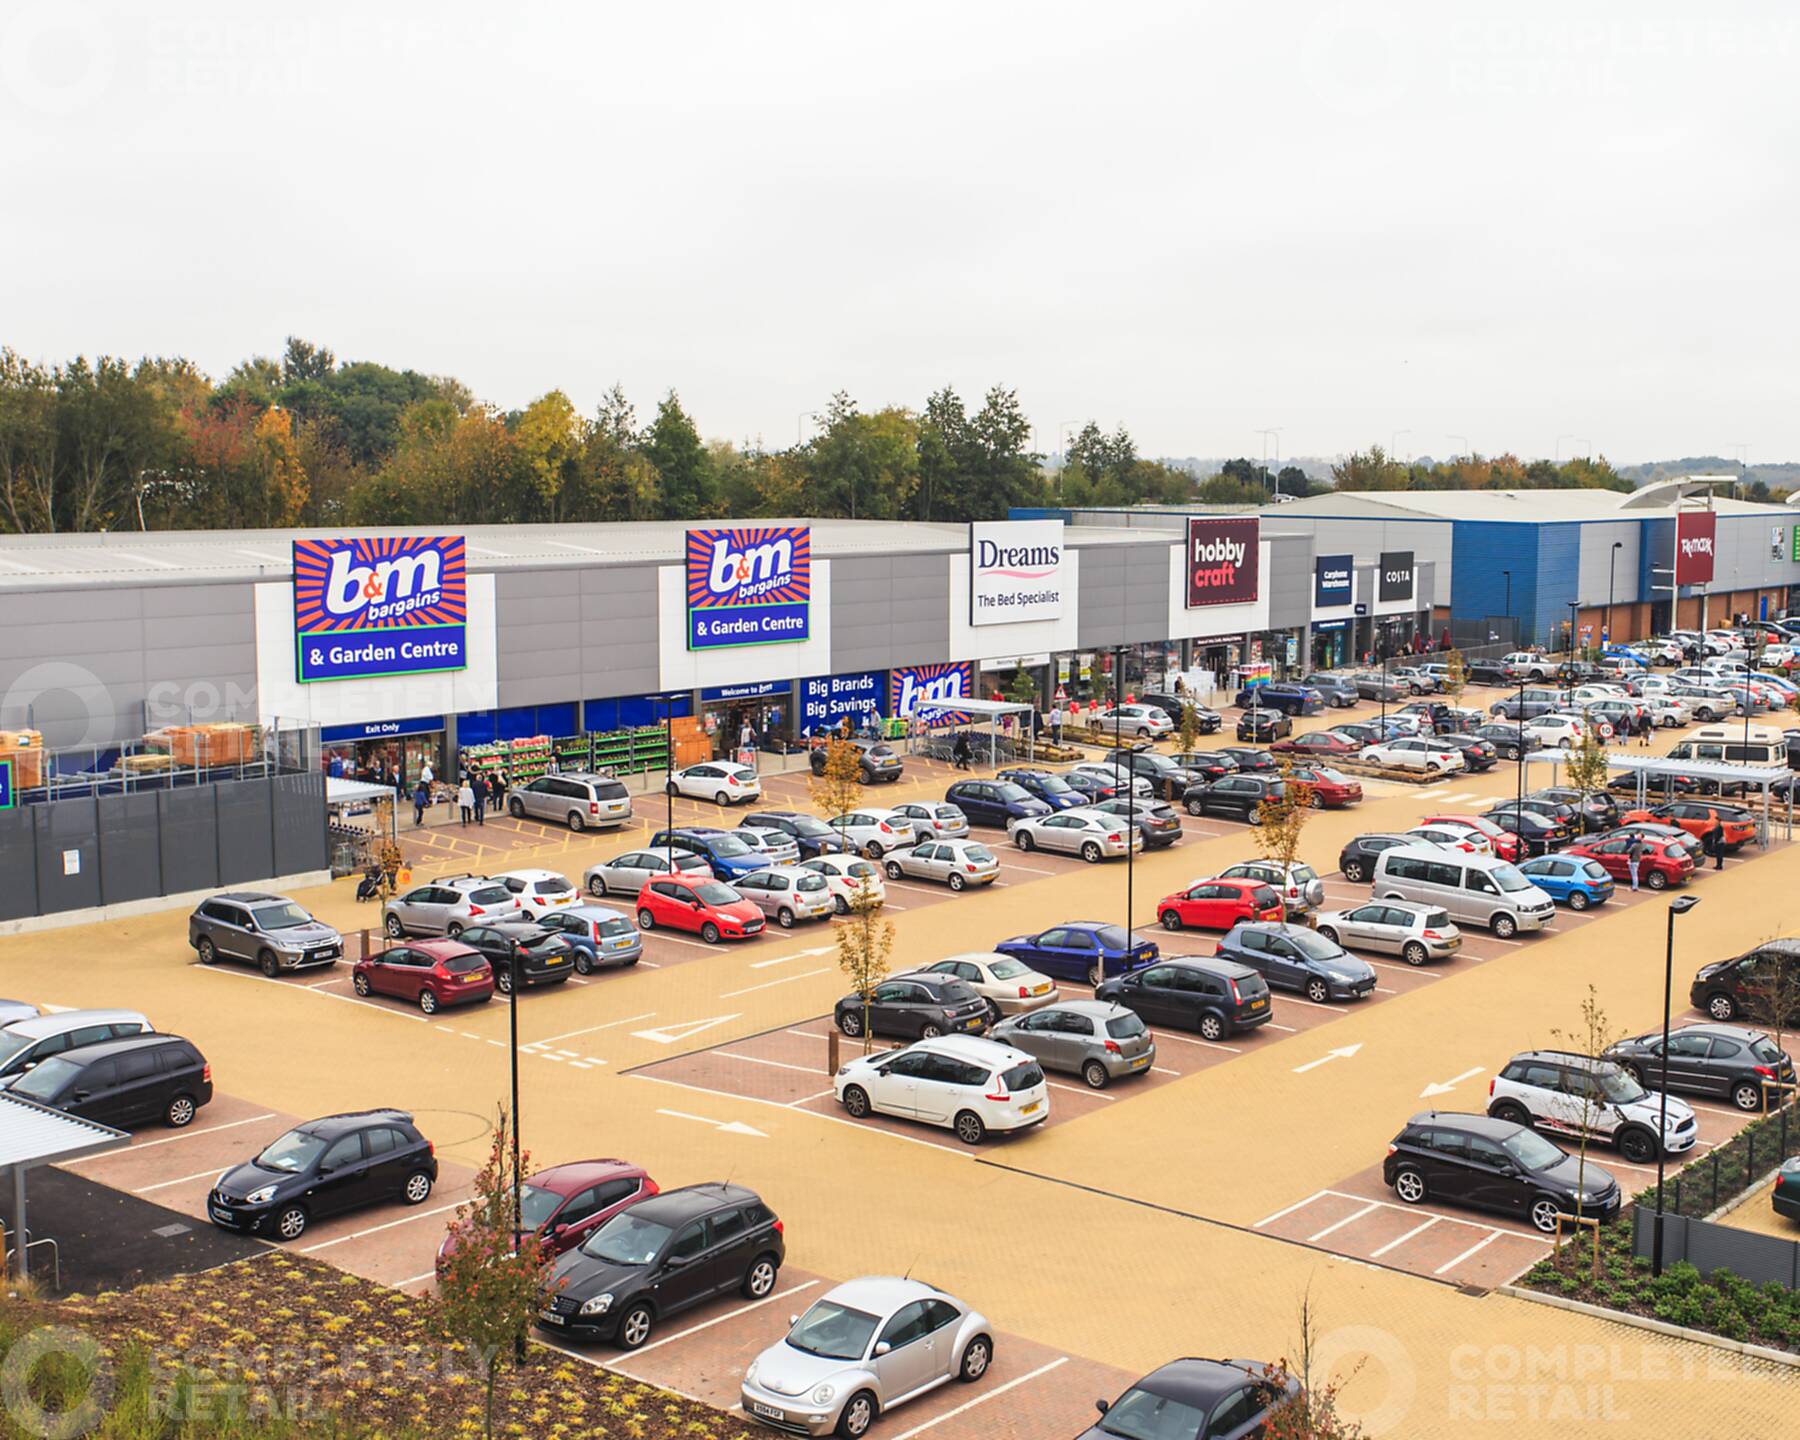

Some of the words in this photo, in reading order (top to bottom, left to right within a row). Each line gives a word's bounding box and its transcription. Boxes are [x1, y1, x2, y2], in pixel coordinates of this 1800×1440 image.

[978, 540, 1059, 568] Dreams
[1195, 537, 1246, 568] hobby
[709, 539, 791, 593] b&m
[1195, 561, 1235, 588] craft
[1386, 571, 1410, 583] COSTA
[326, 550, 442, 614] b&m
[738, 574, 791, 598] bargains
[368, 591, 440, 620] bargains
[978, 595, 995, 607] The
[997, 593, 1015, 606] Bed
[1017, 591, 1059, 607] Specialist
[697, 621, 708, 636] &
[711, 618, 758, 635] Garden
[762, 616, 804, 631] Centre
[310, 648, 324, 665] &
[329, 644, 395, 664] Garden
[401, 641, 458, 659] Centre
[721, 687, 750, 696] Welcome
[808, 680, 828, 696] Big
[832, 675, 874, 692] Brands
[806, 702, 826, 718] Big
[830, 697, 876, 712] Savings
[365, 725, 380, 734] Exit
[382, 723, 400, 732] Only
[1602, 726, 1611, 735] 10
